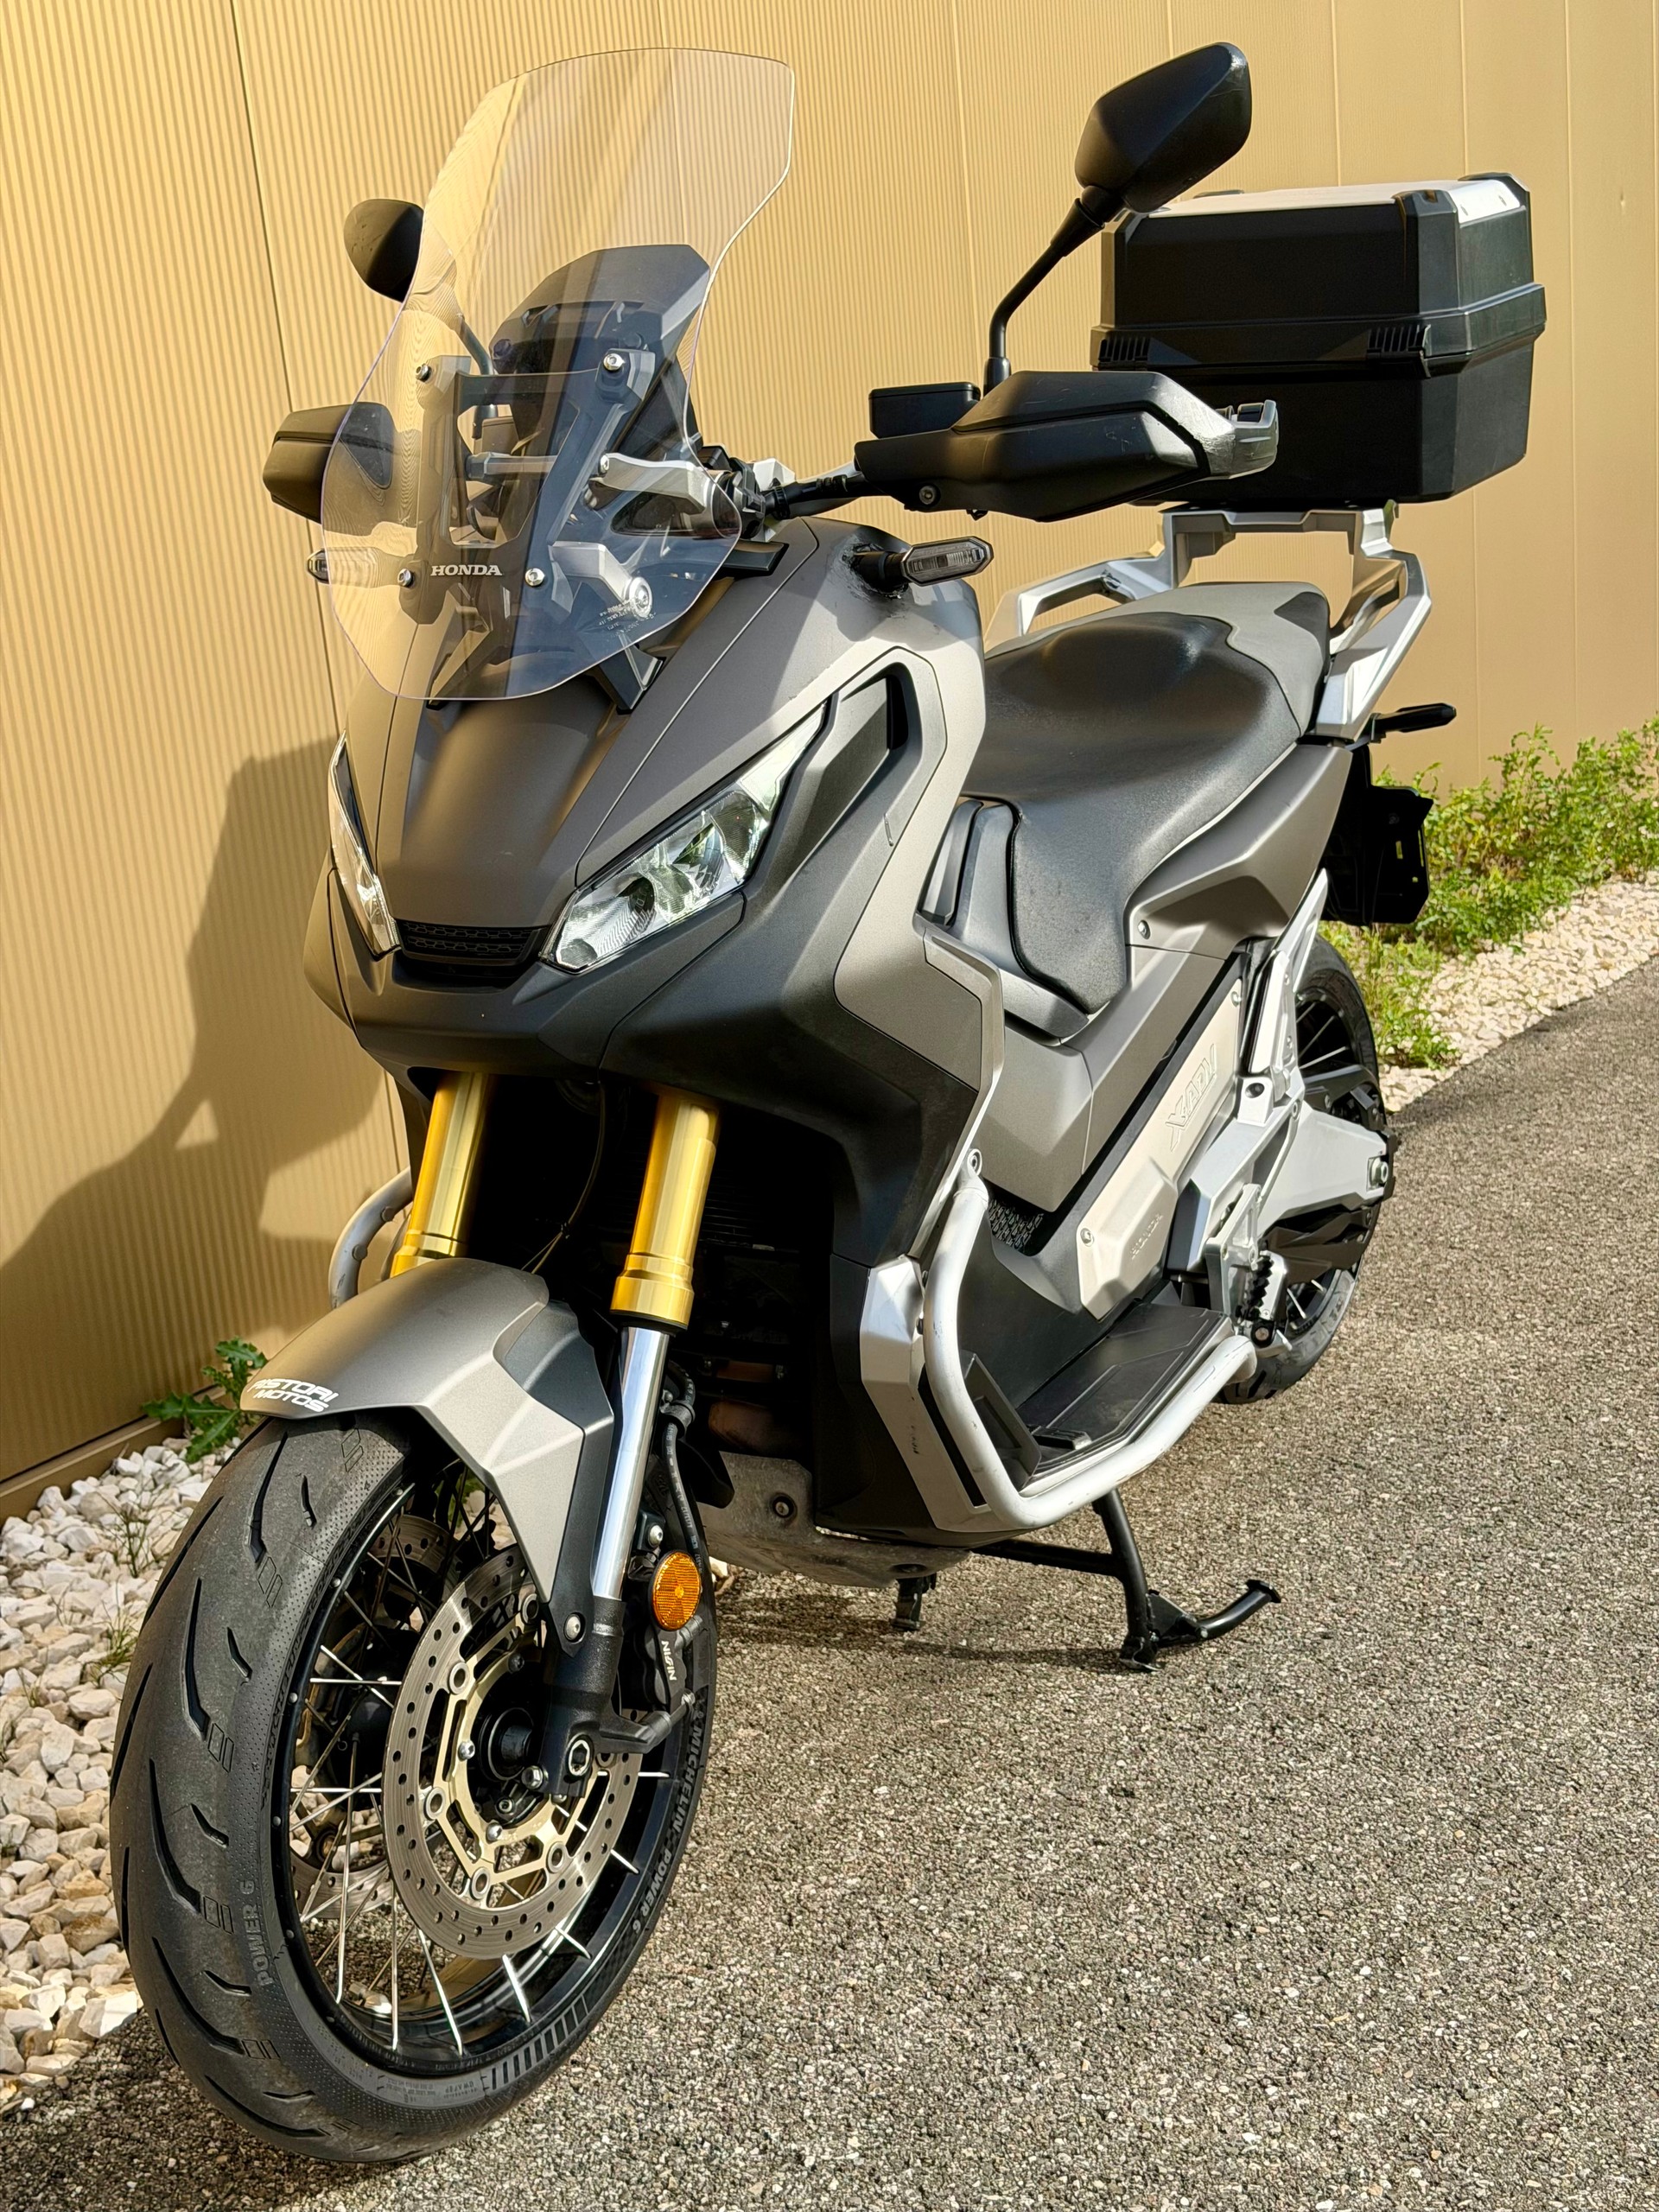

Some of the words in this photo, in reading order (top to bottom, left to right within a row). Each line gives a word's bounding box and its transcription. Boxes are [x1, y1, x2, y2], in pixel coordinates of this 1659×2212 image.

[429, 564, 503, 576] HONDA
[253, 1389, 329, 1412] MOTOS
[672, 1725, 702, 1833] MICHELIN
[640, 1849, 672, 1916] POWER
[243, 1904, 275, 1986] POWER
[632, 1919, 641, 1934] 6
